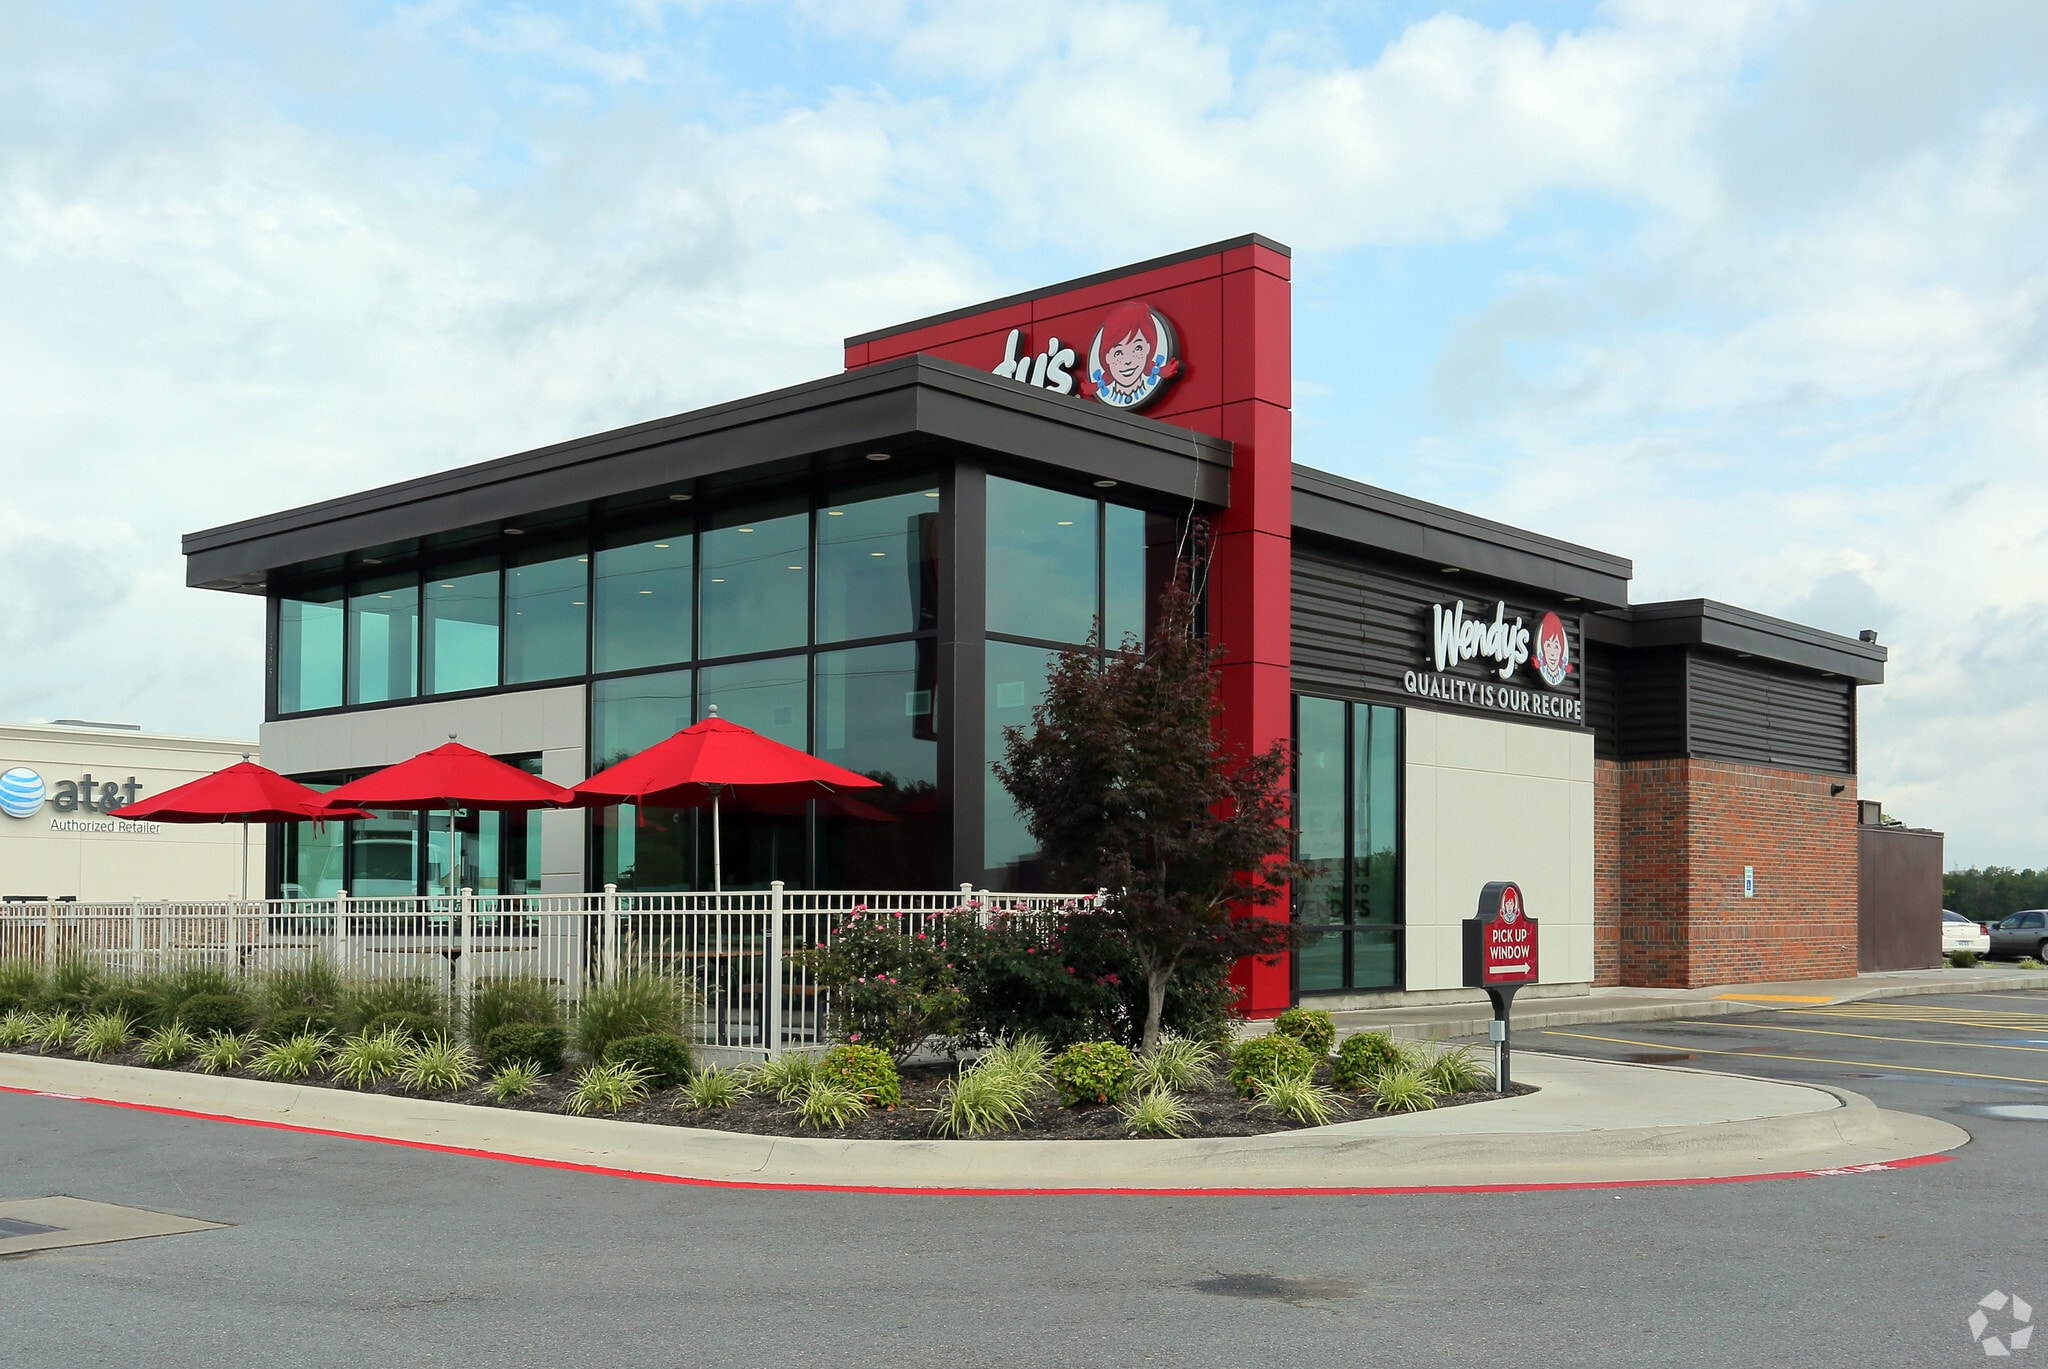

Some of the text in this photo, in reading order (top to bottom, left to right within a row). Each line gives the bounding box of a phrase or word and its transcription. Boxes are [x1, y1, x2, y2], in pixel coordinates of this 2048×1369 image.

[1432, 599, 1531, 680] Wendy's
[1404, 670, 1582, 720] QUALITY IS OUR RECIPE
[53, 773, 143, 815] at&t
[50, 818, 161, 834] Authorized Retailer
[1492, 928, 1528, 943] PICK UP
[1490, 945, 1530, 960] WINDOW
